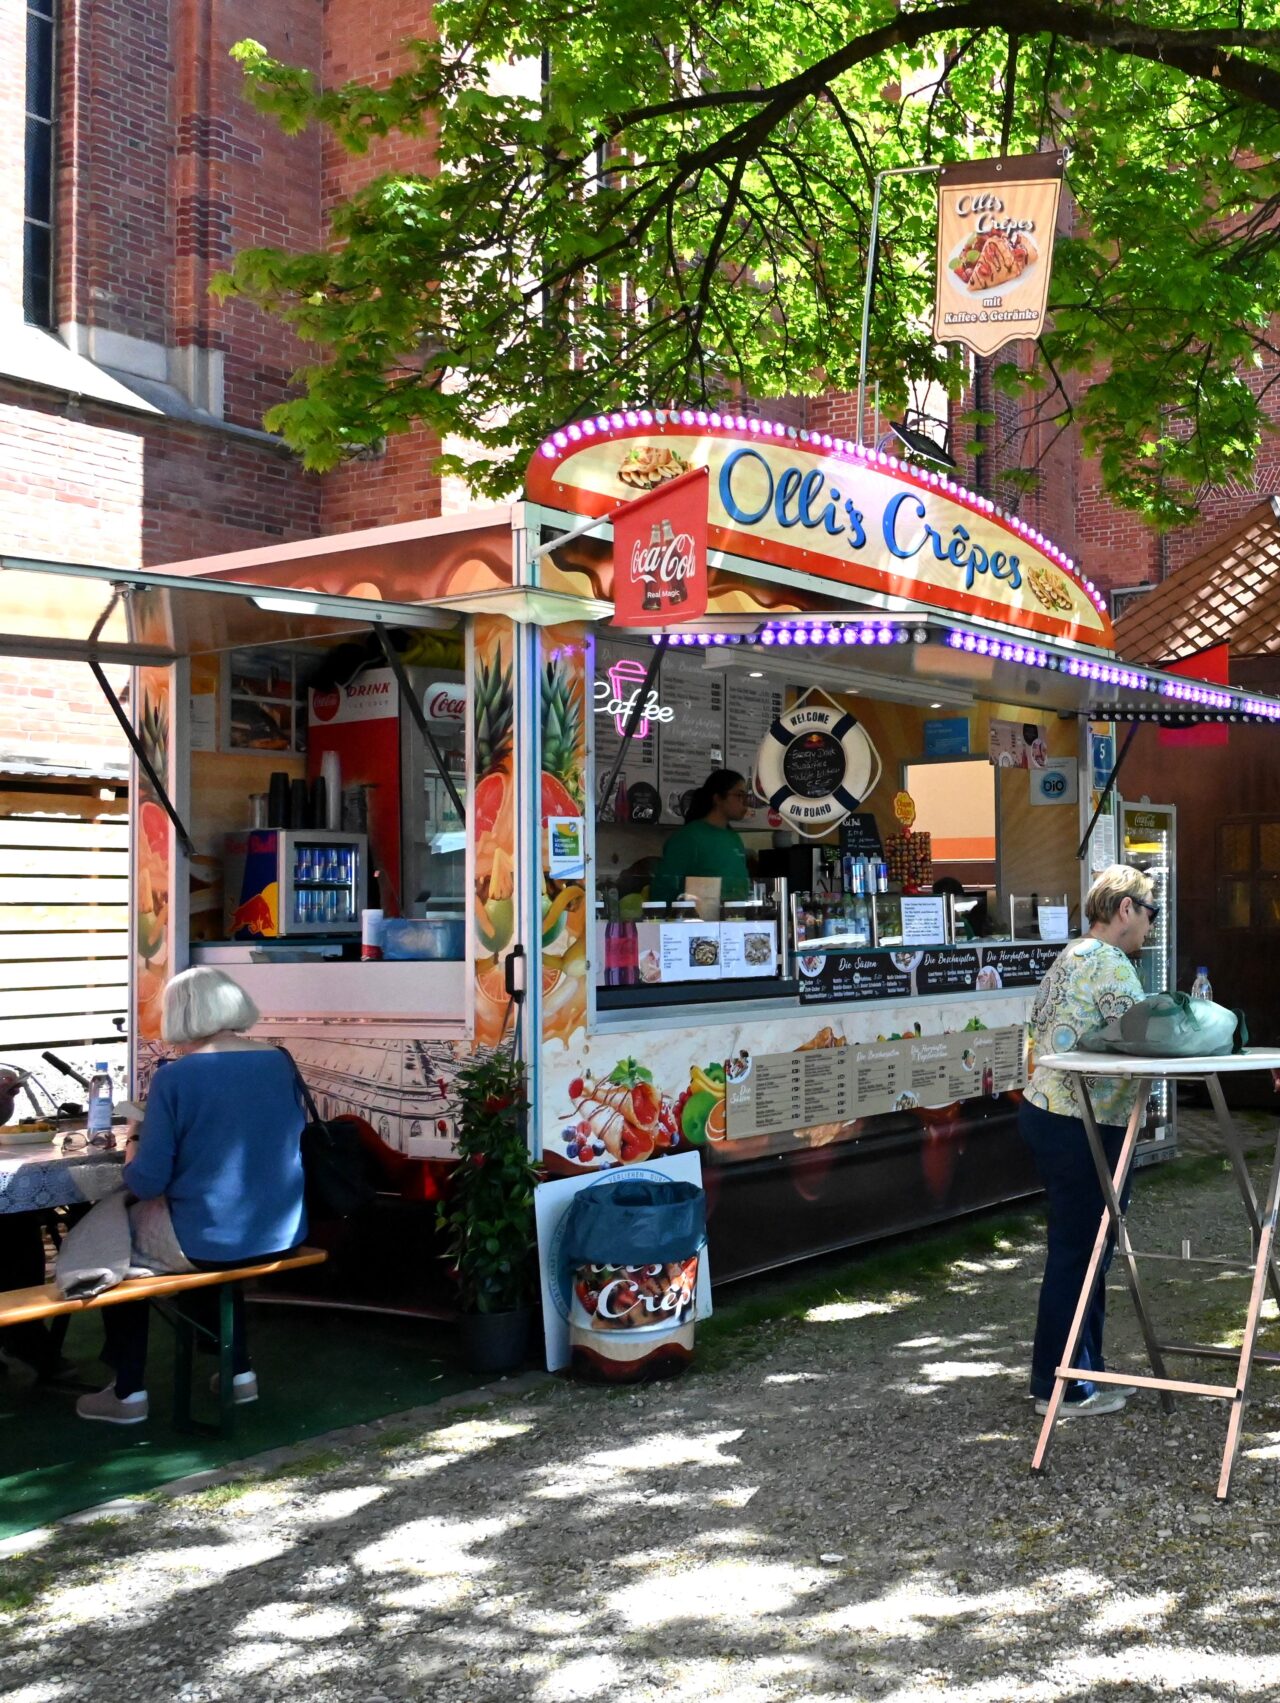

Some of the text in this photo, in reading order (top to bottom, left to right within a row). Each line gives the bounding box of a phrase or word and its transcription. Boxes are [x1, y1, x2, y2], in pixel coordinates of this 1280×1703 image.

[982, 295, 1002, 307] mit
[944, 309, 1039, 324] Kaffee & Getränke
[882, 491, 1022, 590] Crêpes
[662, 589, 680, 598] Magic
[346, 682, 391, 697] DRINK
[790, 712, 830, 726] WELCOME
[790, 803, 832, 817] ON BOARD
[924, 953, 936, 965] Die
[987, 950, 997, 962] Die
[838, 958, 852, 971] Die
[597, 1279, 696, 1321] Crêp
